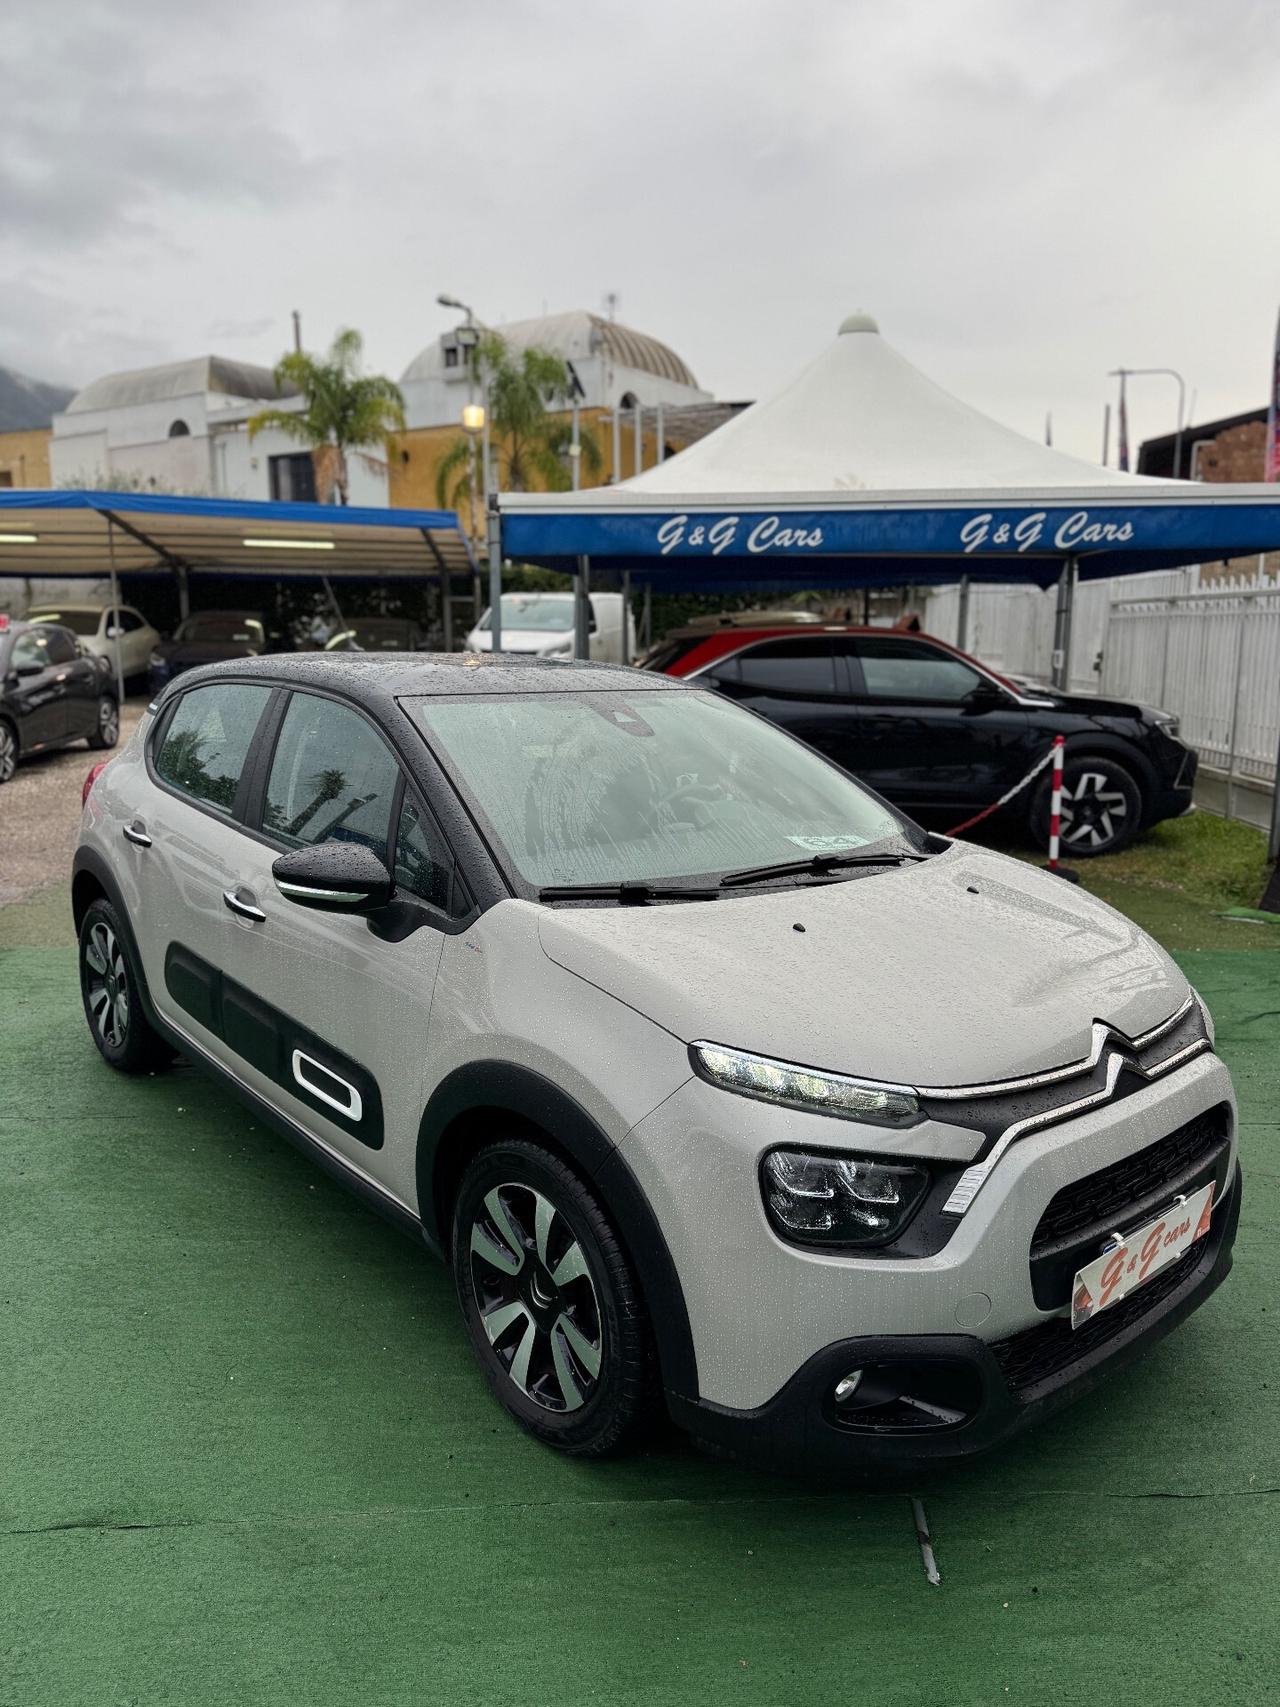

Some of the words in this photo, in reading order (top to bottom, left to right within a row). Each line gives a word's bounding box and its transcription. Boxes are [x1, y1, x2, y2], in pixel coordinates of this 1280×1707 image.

[747, 515, 825, 554] Cars
[1053, 511, 1135, 550] Cars
[1163, 1216, 1192, 1248] cars
